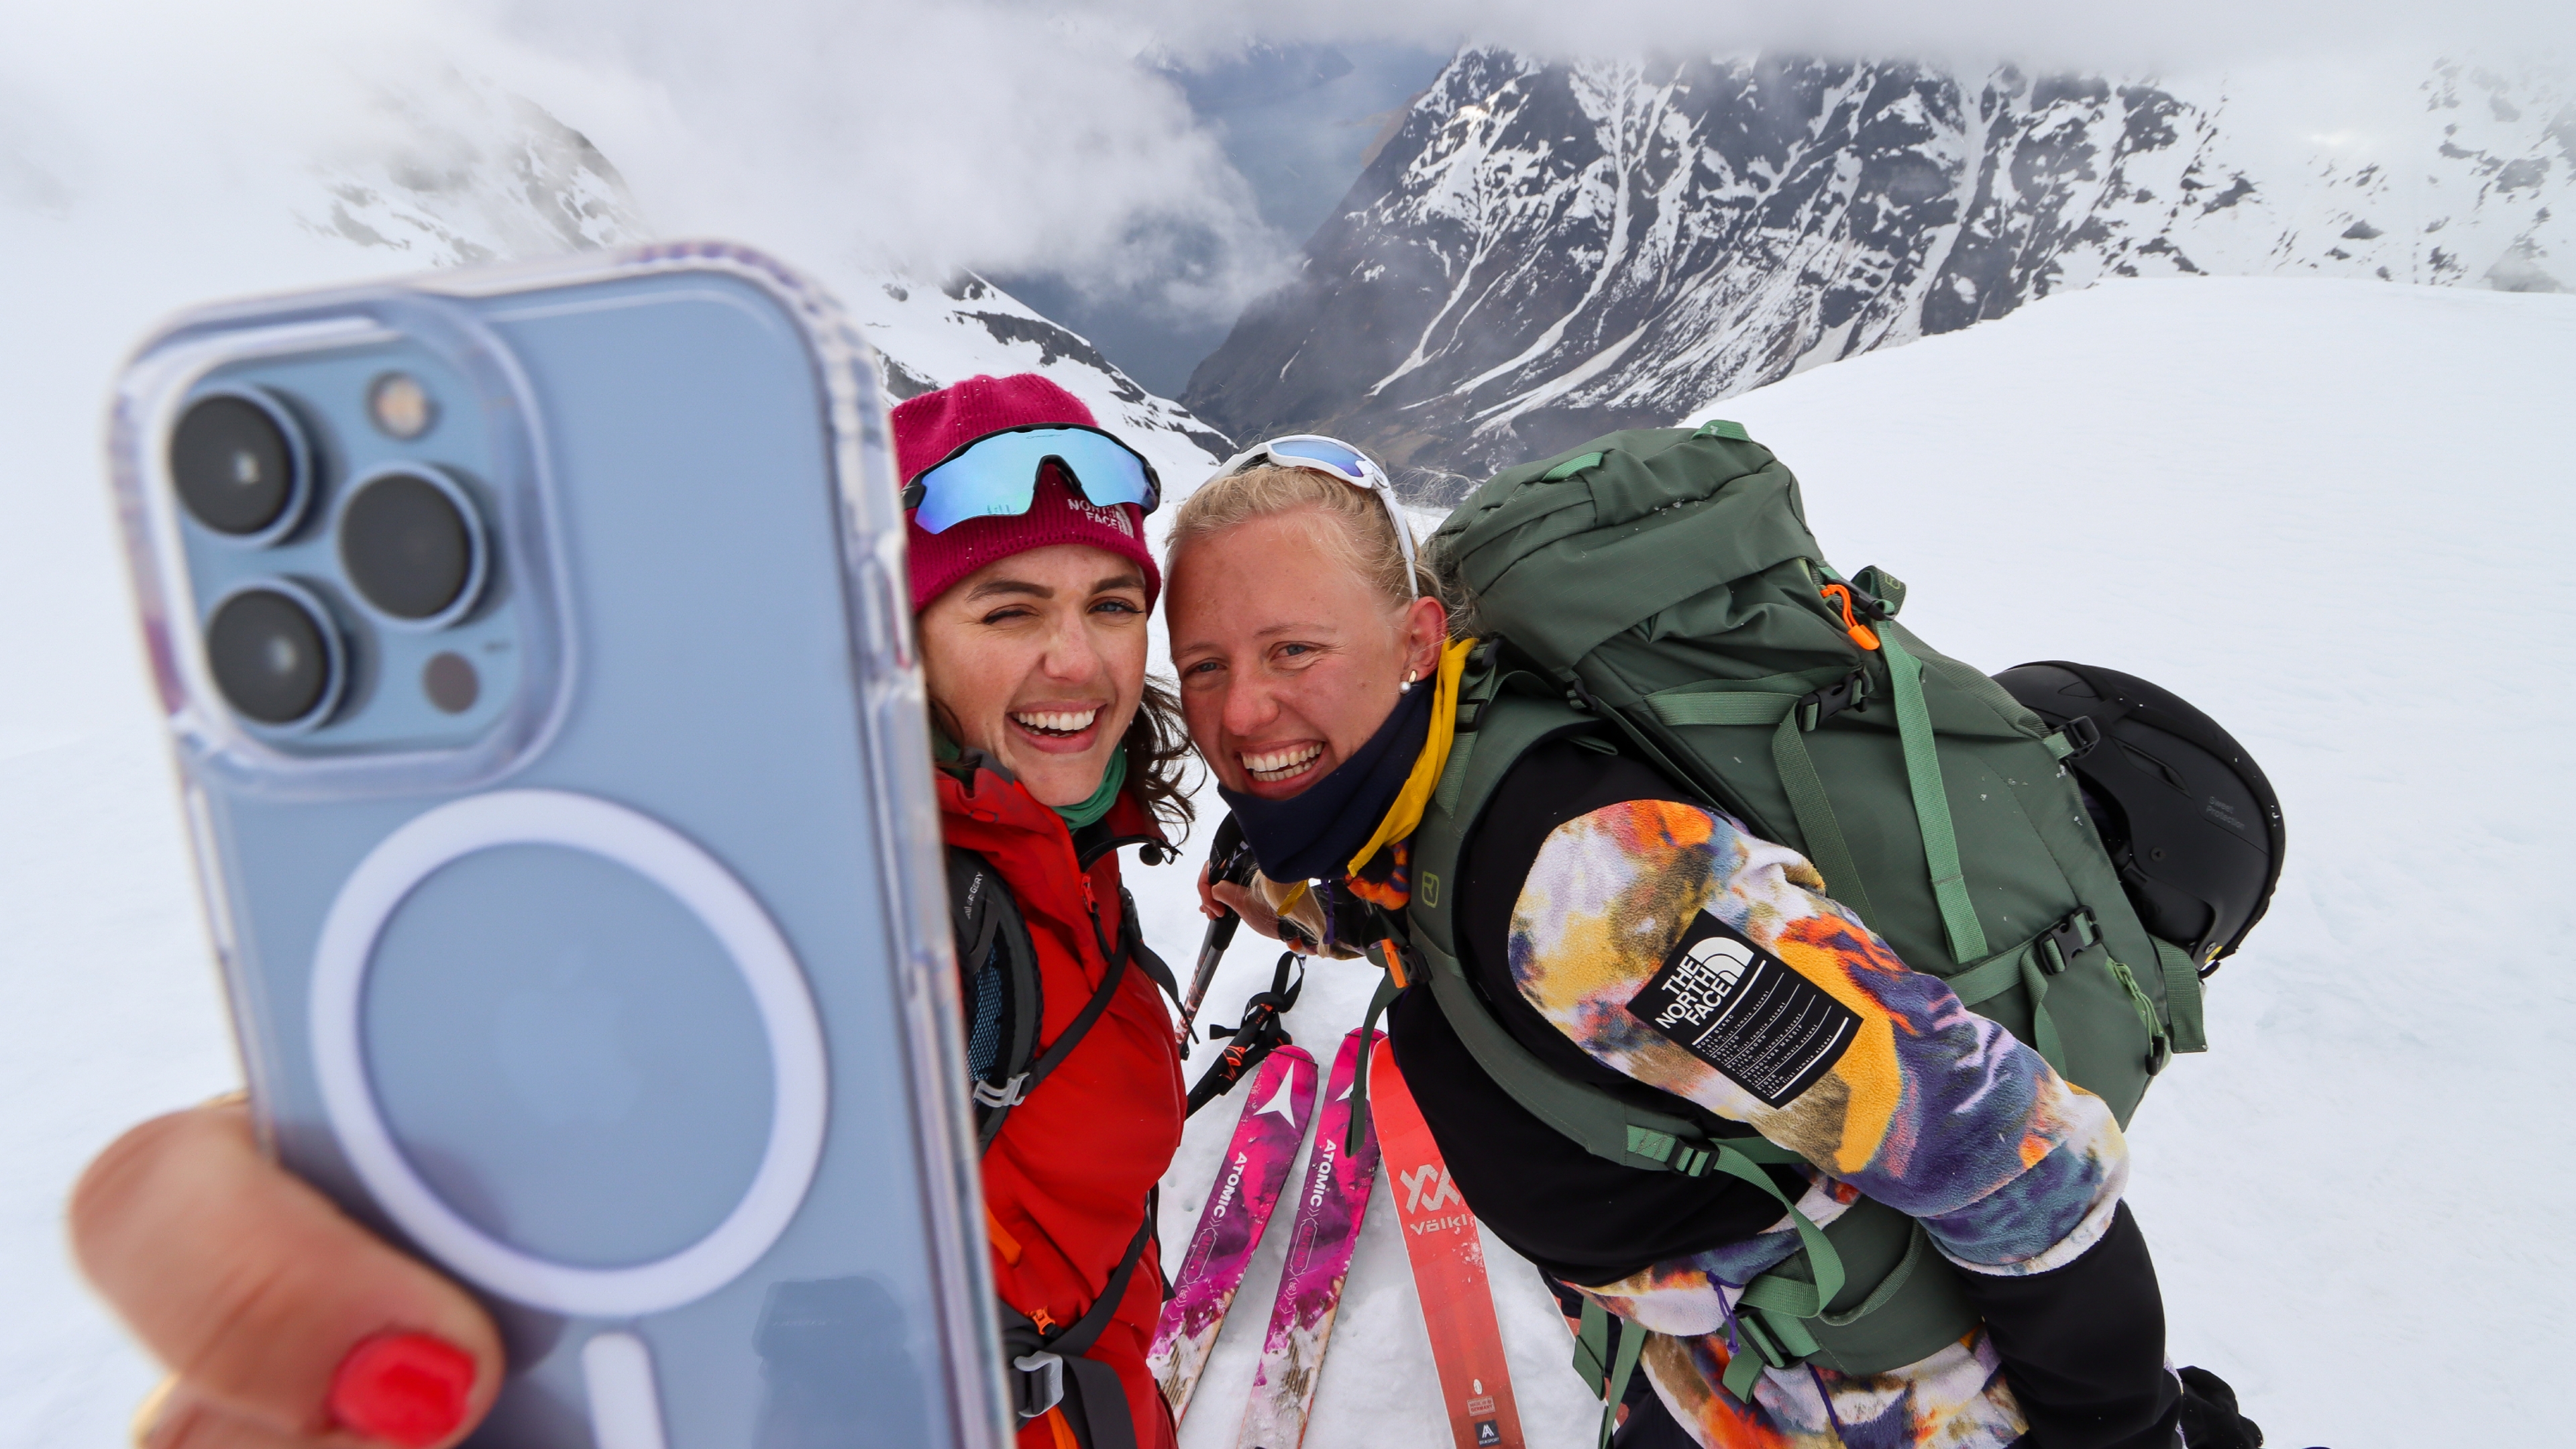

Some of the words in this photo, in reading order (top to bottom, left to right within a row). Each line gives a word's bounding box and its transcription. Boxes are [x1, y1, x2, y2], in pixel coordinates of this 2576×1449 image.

[1085, 512, 1118, 529] FACE
[2206, 805, 2245, 830] Protection
[2209, 796, 2233, 814] Sweet
[967, 871, 983, 906] GRGORY
[1661, 955, 1701, 995] THE
[1655, 967, 1717, 1029] NORTH
[1684, 977, 1732, 1026] FACE
[1695, 1034, 1713, 1049] MONT
[1713, 1013, 1734, 1034] BLANC
[1726, 1034, 1766, 1069] MATTERHORN
[1741, 1048, 1780, 1079] MARMOLADA
[1779, 1024, 1803, 1047] MASSIF
[1756, 1073, 1776, 1090] EIGER
[1213, 1151, 1248, 1218] ATOMIC
[1310, 1138, 1337, 1208] ATOMIC
[1410, 1214, 1468, 1236] Völkl
[1288, 1282, 1297, 1291] 86
[1470, 1404, 1493, 1412] GERMANY
